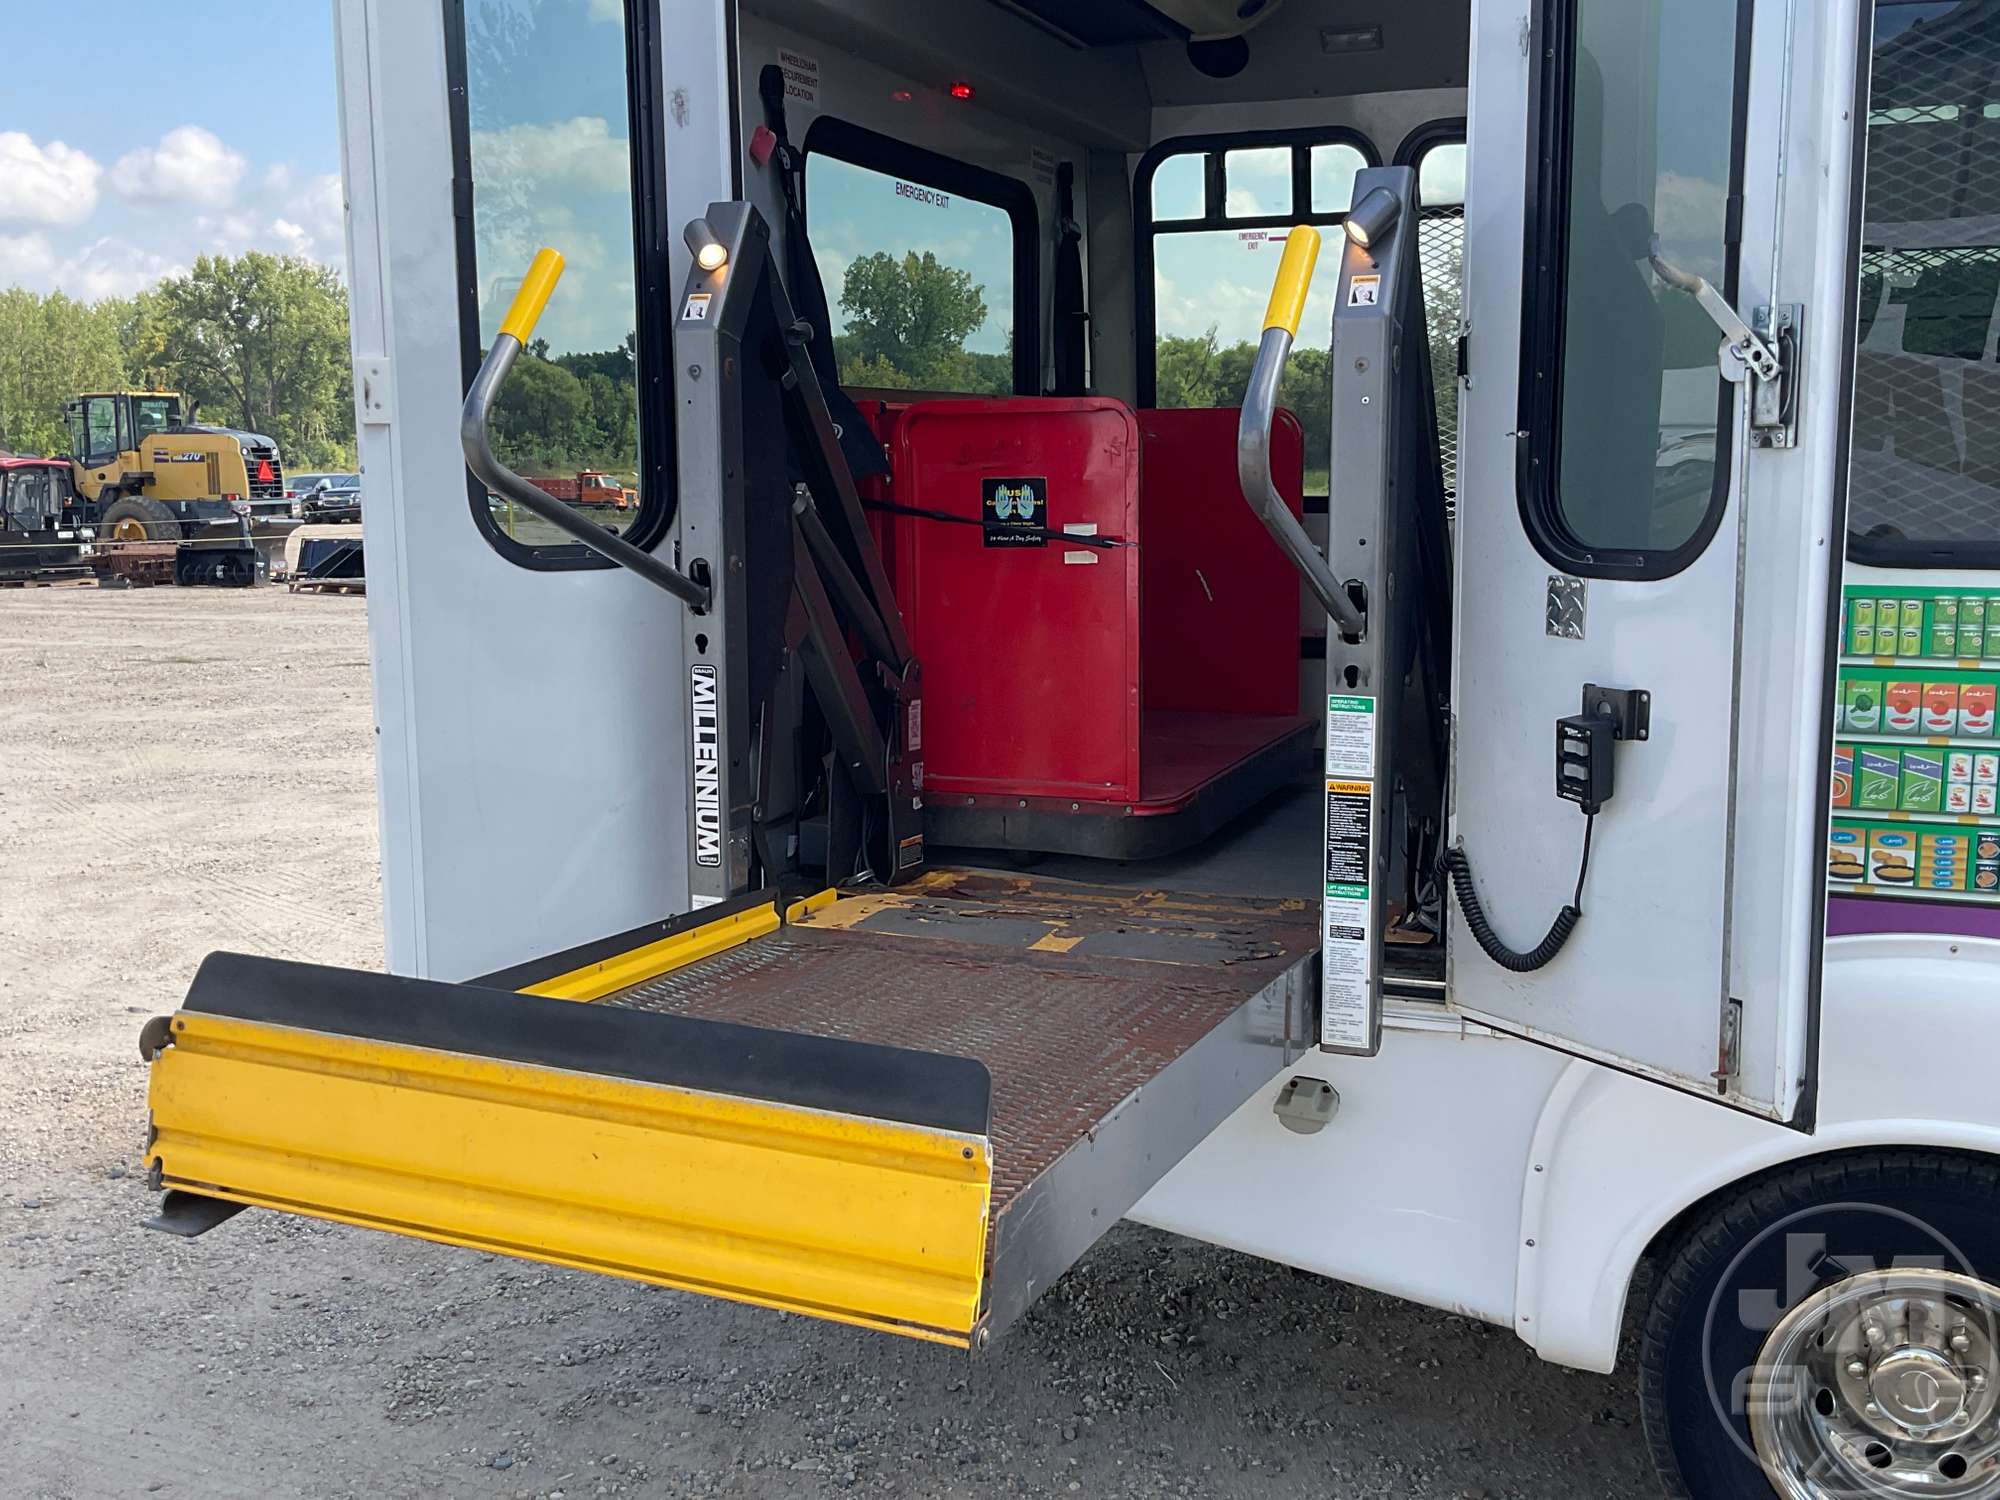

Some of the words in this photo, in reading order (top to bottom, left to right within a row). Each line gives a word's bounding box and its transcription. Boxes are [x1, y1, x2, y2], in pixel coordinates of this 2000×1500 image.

[895, 181, 936, 204] EMERGENCY
[935, 193, 950, 208] EXIT
[692, 673, 720, 857] MILLENNIUM
[1335, 783, 1370, 792] WARNING
